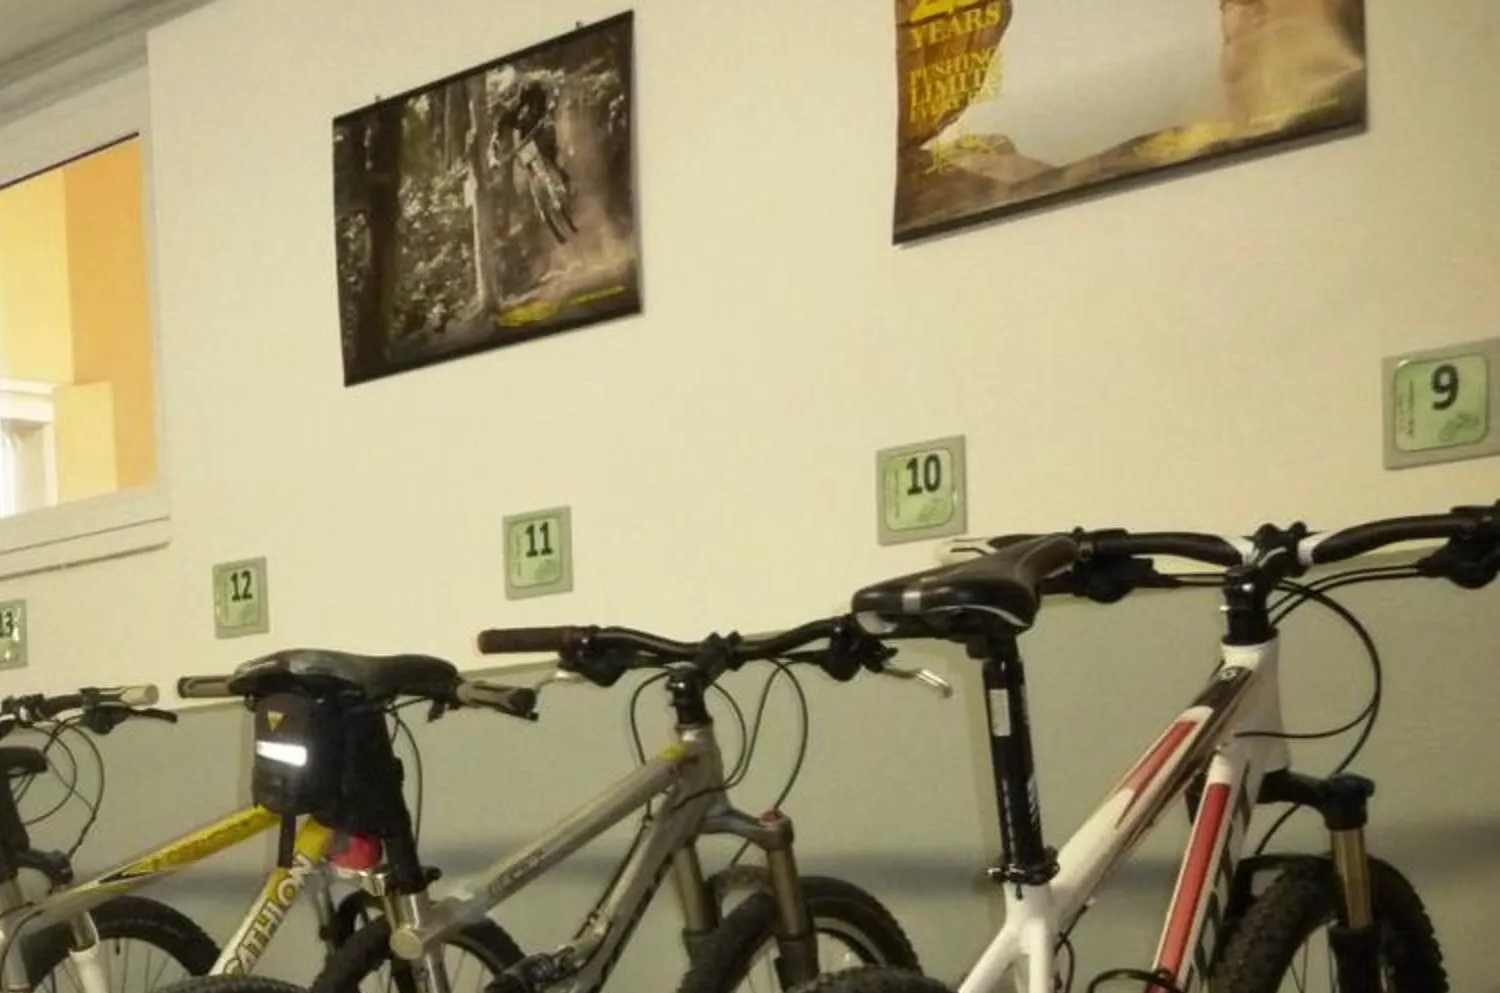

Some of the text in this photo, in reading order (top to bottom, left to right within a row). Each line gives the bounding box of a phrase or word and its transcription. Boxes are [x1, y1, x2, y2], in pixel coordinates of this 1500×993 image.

[911, 3, 1001, 48] YEARS
[1431, 364, 1460, 411] 9
[906, 454, 941, 496] 10
[525, 521, 555, 559] 11
[231, 570, 253, 602] 12
